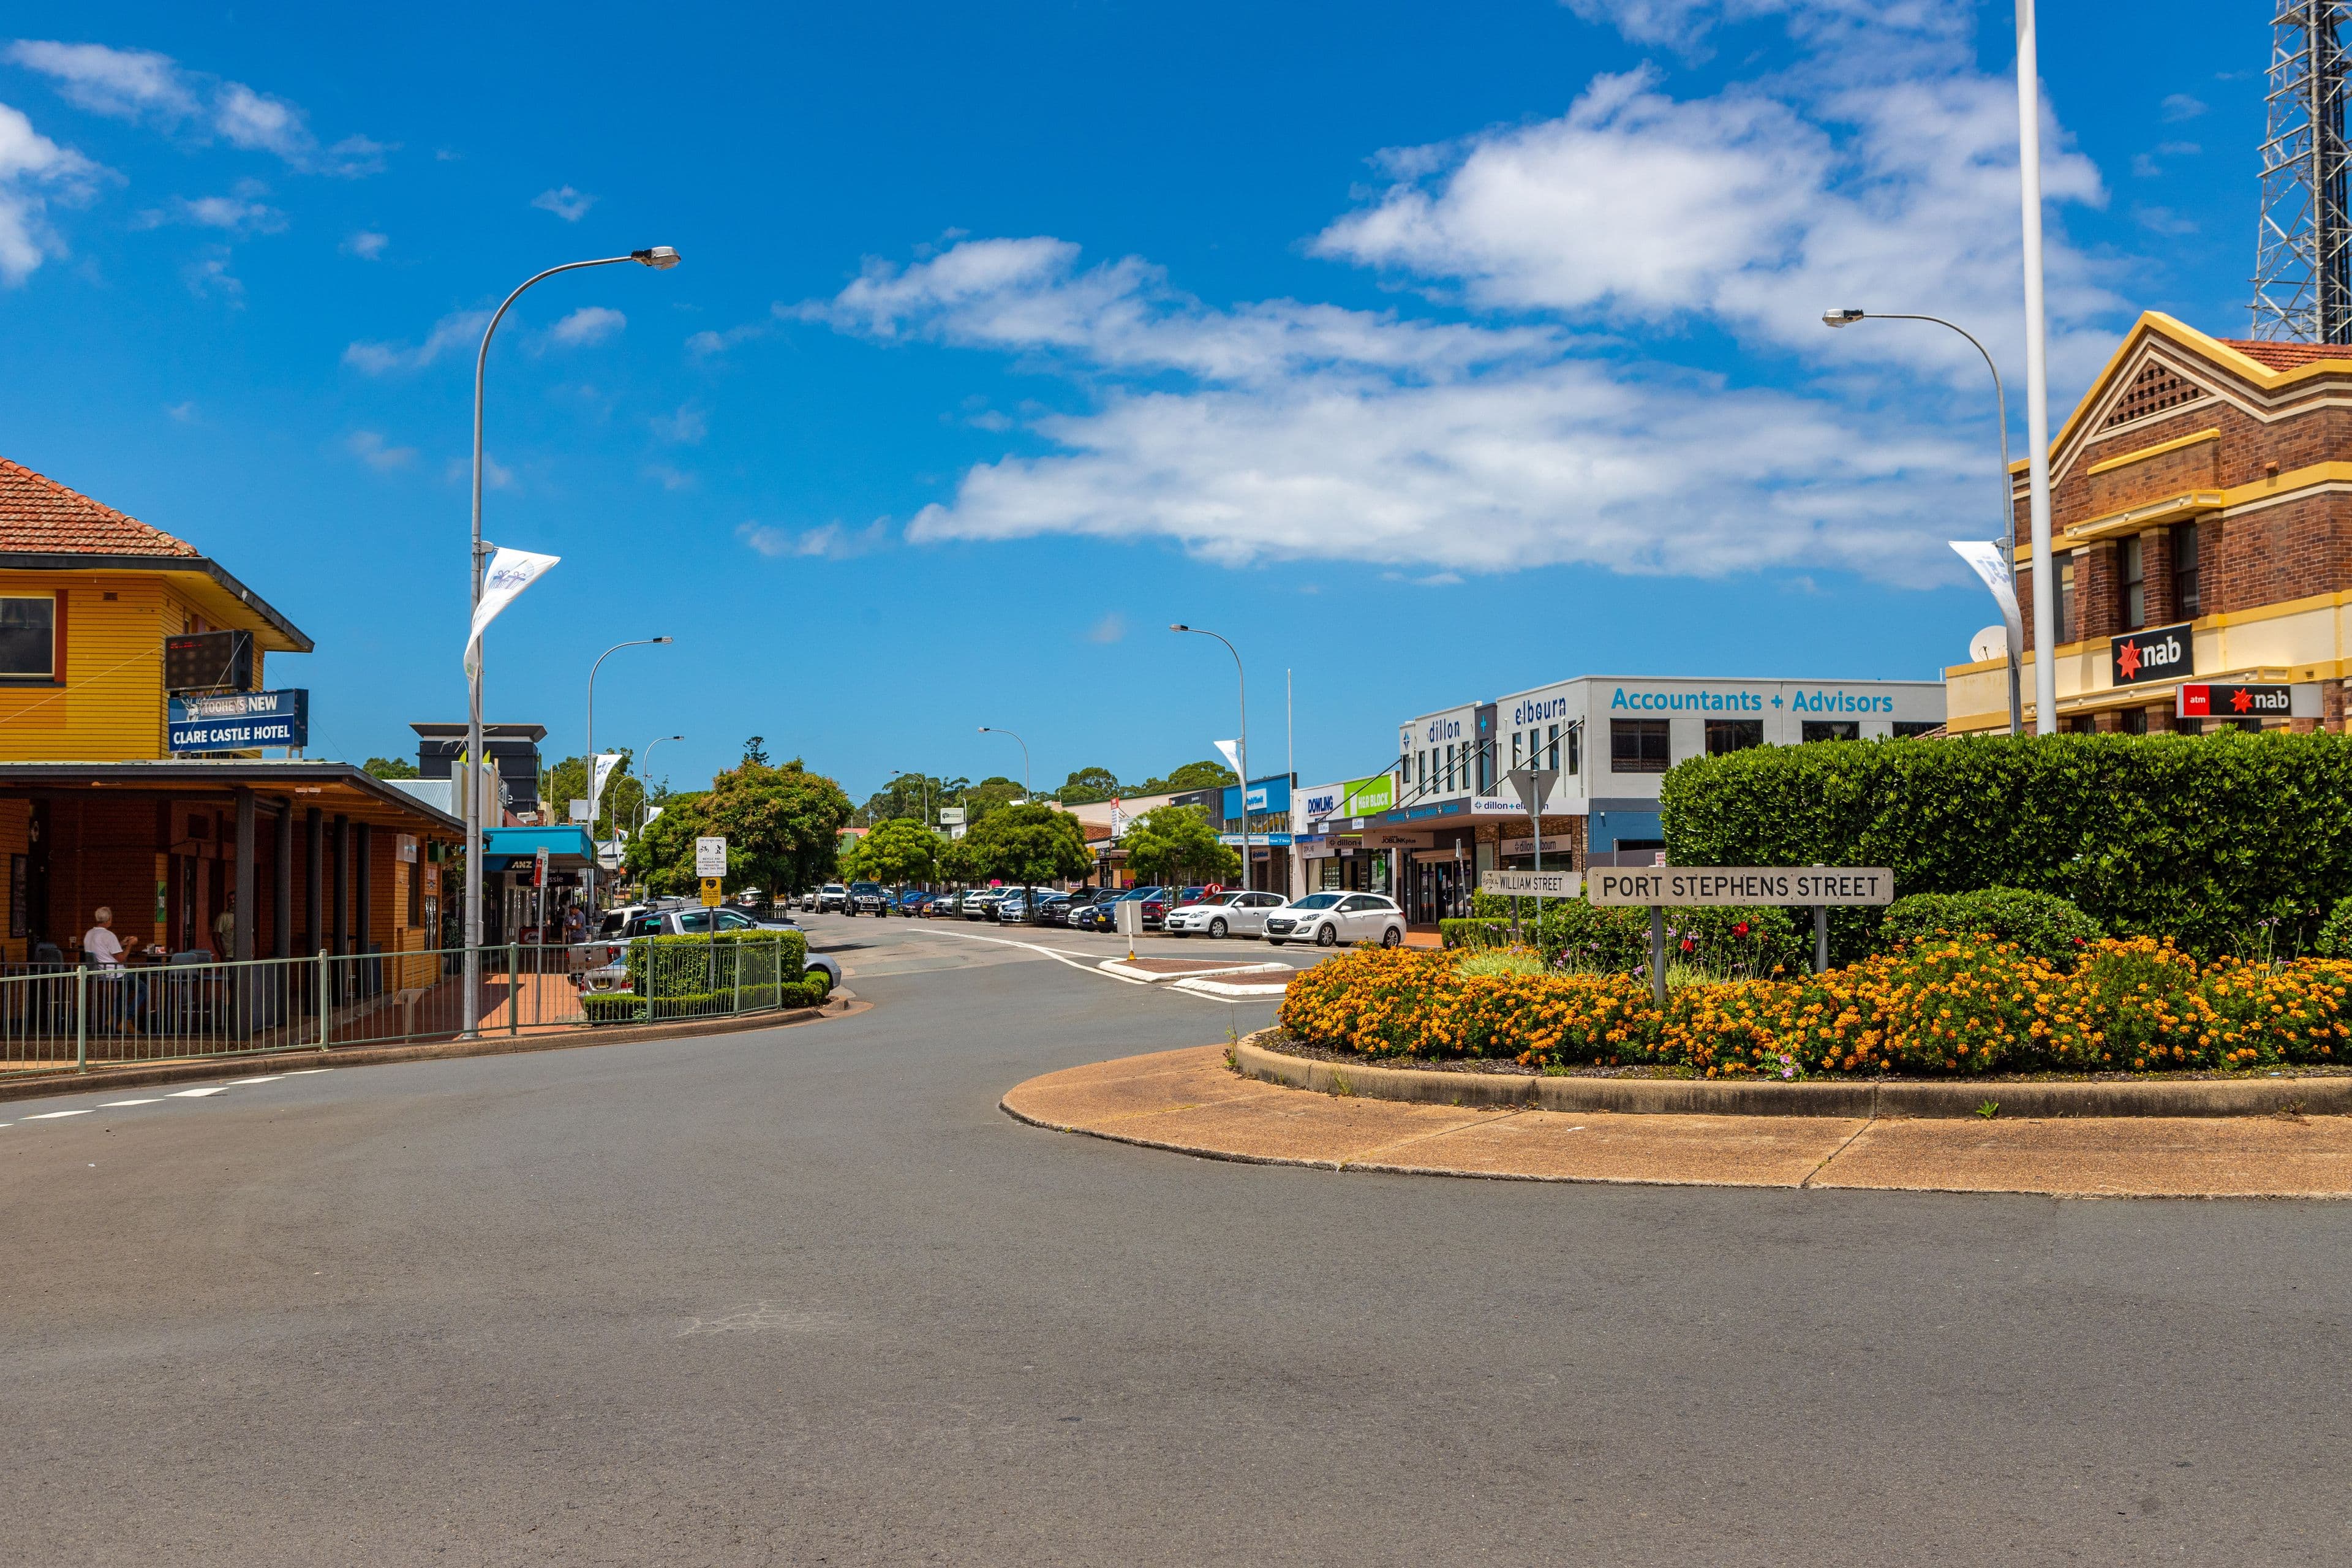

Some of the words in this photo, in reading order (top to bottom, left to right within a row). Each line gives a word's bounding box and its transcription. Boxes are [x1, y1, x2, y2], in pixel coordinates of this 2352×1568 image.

[2143, 636, 2181, 667] nab
[204, 698, 245, 713] TOOHEYS
[249, 696, 277, 712] NEW
[1611, 688, 1762, 711] Accountants
[1771, 693, 1783, 709] +
[1792, 690, 1893, 712] Advisors
[2255, 690, 2288, 709] nab
[1429, 718, 1460, 743] dillon
[1515, 697, 1566, 726] elbourn
[173, 730, 207, 744] CLARE
[210, 727, 251, 742] CASTLE
[254, 725, 290, 739] HOTEL
[1308, 796, 1333, 813] DOWLING
[1358, 795, 1369, 809] H&R
[1371, 792, 1389, 807] BLOCK
[1387, 812, 1404, 822] Accounting
[1411, 809, 1425, 818] Business
[1442, 804, 1459, 814] Taxation
[1520, 840, 1533, 851] dillon
[1539, 840, 1556, 851] lbourn
[1501, 876, 1531, 890] WILLIAM
[1534, 878, 1562, 891] STREET
[1604, 876, 1662, 897] PORT
[1672, 876, 1789, 897] STEPHENS
[1797, 876, 1879, 897] STREET
